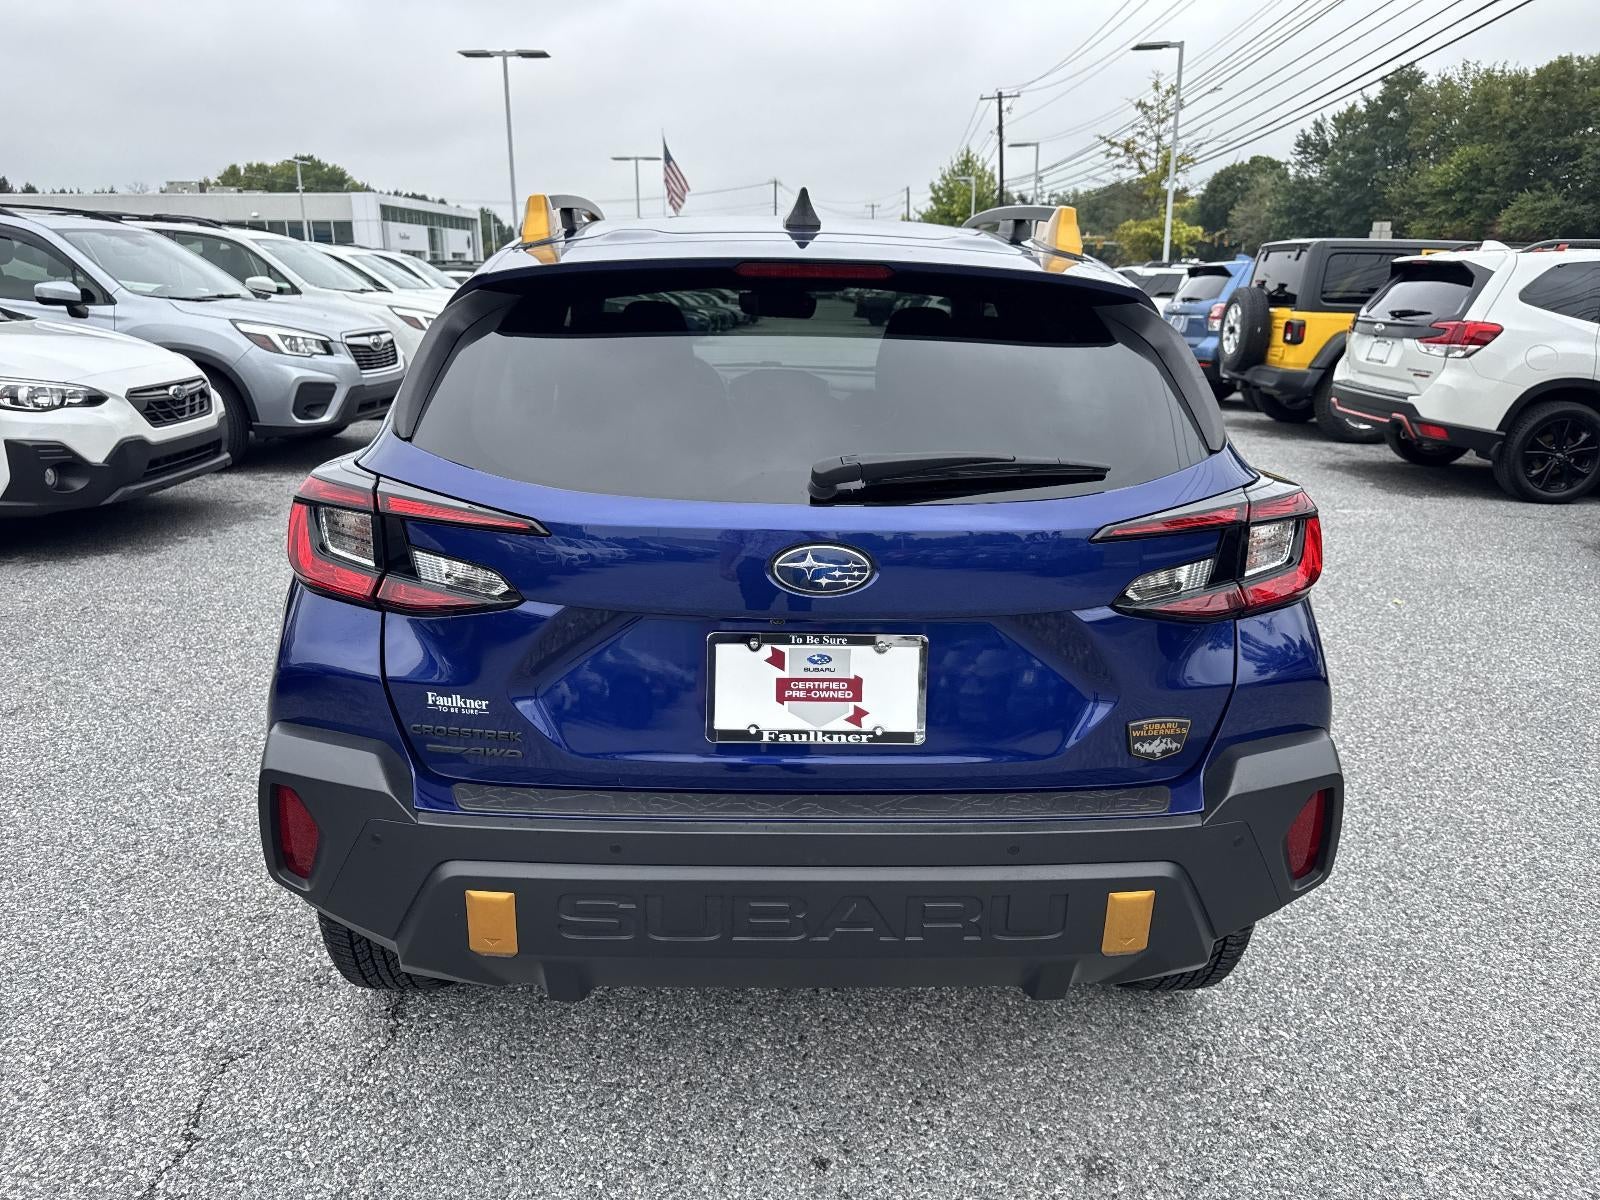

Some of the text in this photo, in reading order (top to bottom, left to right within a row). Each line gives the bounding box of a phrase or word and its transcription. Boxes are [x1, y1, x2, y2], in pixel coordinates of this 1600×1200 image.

[789, 635, 848, 645] To Be Sure
[790, 681, 848, 690] CERTIFIED
[784, 690, 853, 699] PRE-OWNED
[426, 691, 489, 710] Faulkner
[1132, 727, 1187, 737] WILDERNESS
[1142, 722, 1178, 731] SUBARU
[410, 724, 522, 742] CROSSTREK
[760, 730, 873, 743] Faulkner
[463, 747, 523, 759] AWD
[557, 893, 1069, 942] SUBARU
